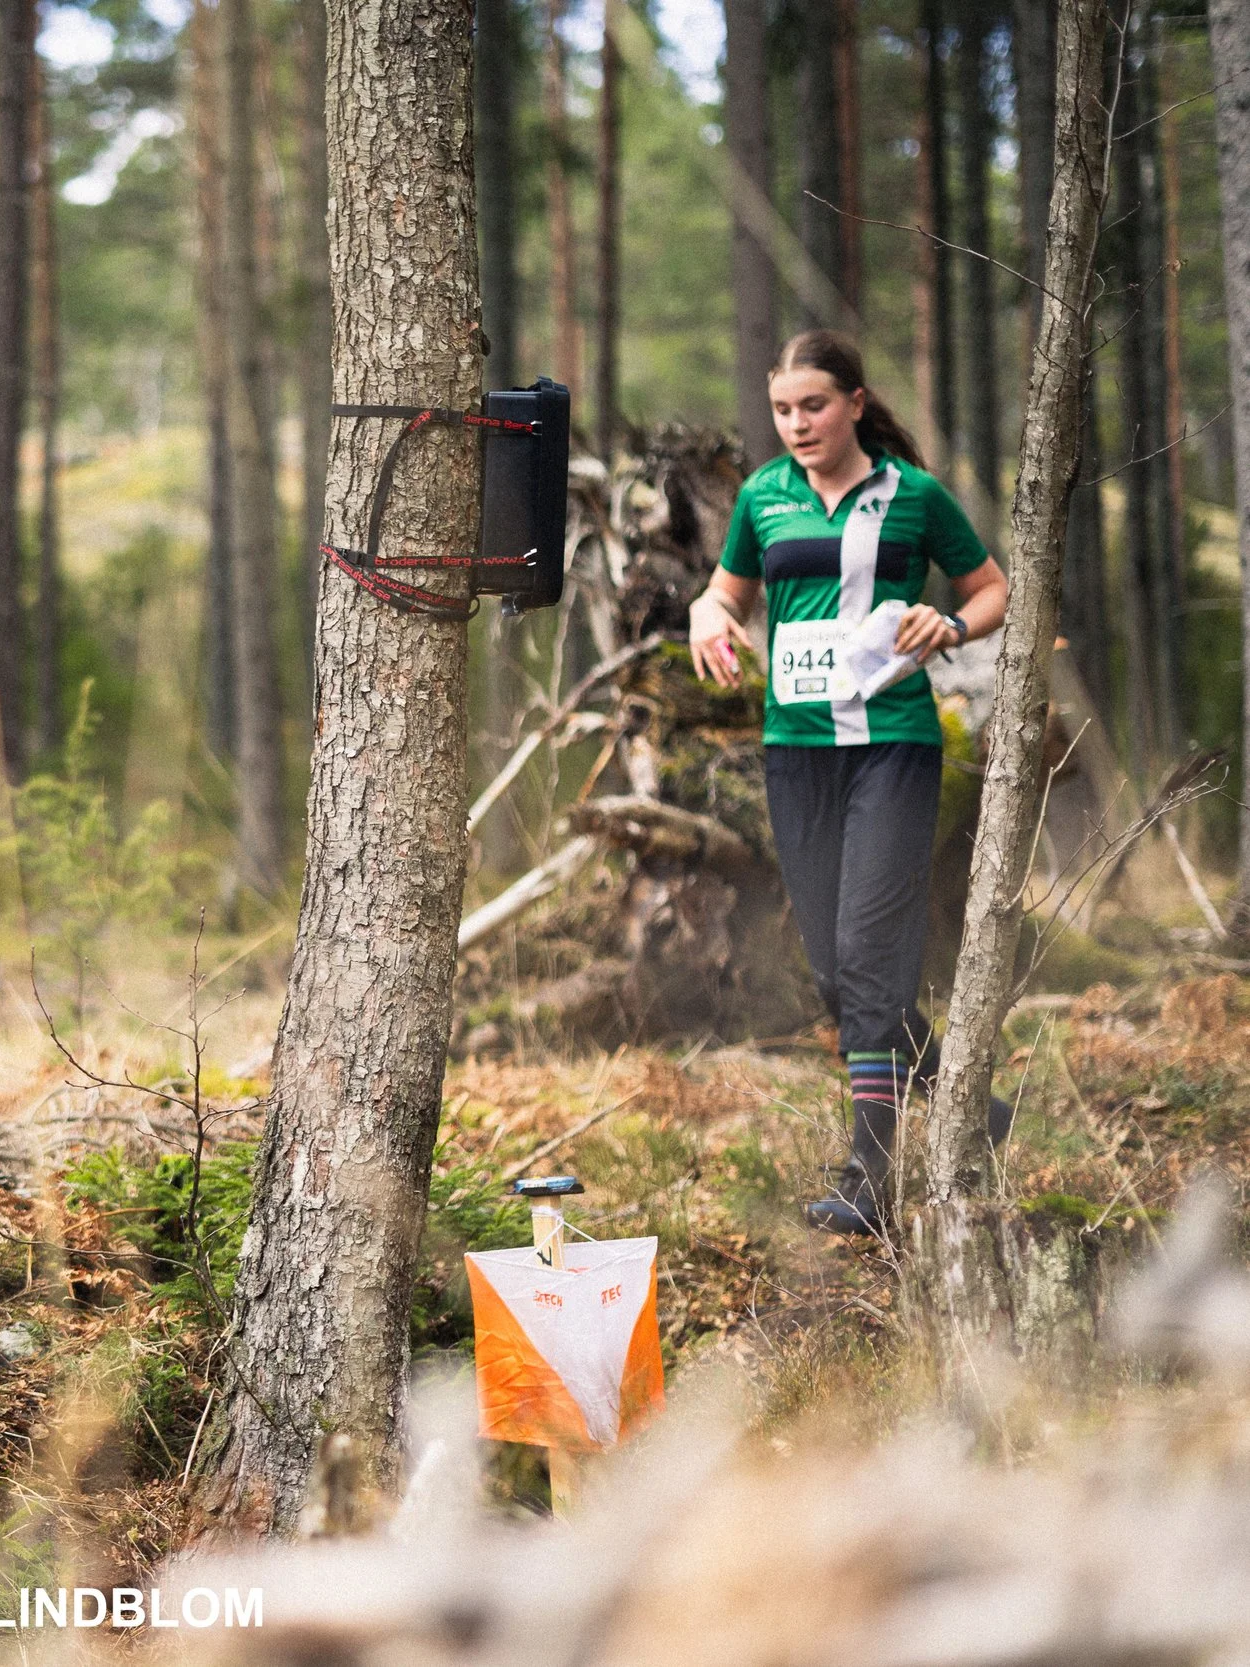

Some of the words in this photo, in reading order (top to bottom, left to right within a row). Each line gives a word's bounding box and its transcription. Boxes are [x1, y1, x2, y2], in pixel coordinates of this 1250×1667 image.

[441, 555, 472, 569] Berg
[331, 552, 391, 601] resultat.se
[783, 648, 836, 675] 944
